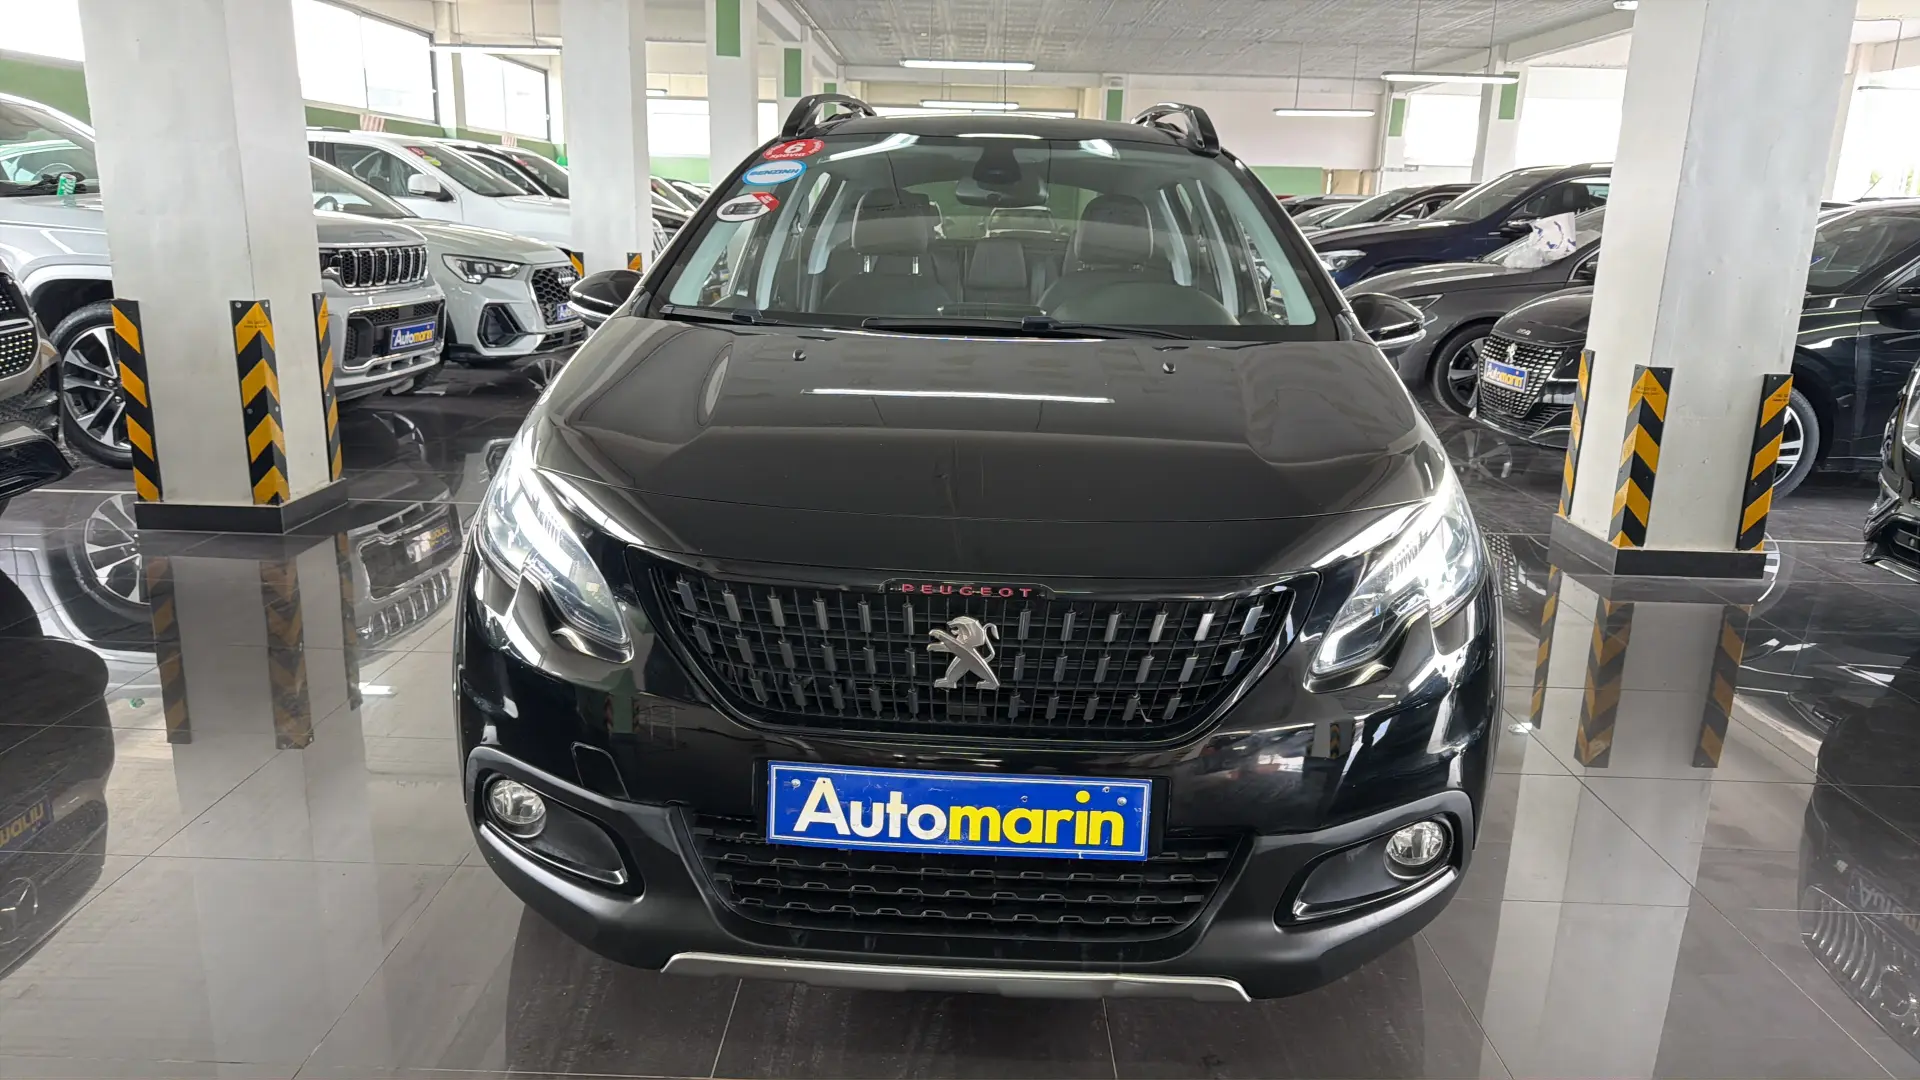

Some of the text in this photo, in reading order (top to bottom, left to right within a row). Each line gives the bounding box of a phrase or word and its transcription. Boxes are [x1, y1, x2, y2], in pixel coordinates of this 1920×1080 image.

[784, 143, 806, 154] 6
[393, 326, 433, 347] Automarin
[902, 583, 1032, 597] PEUGEOT
[793, 777, 1124, 846] Automarin
